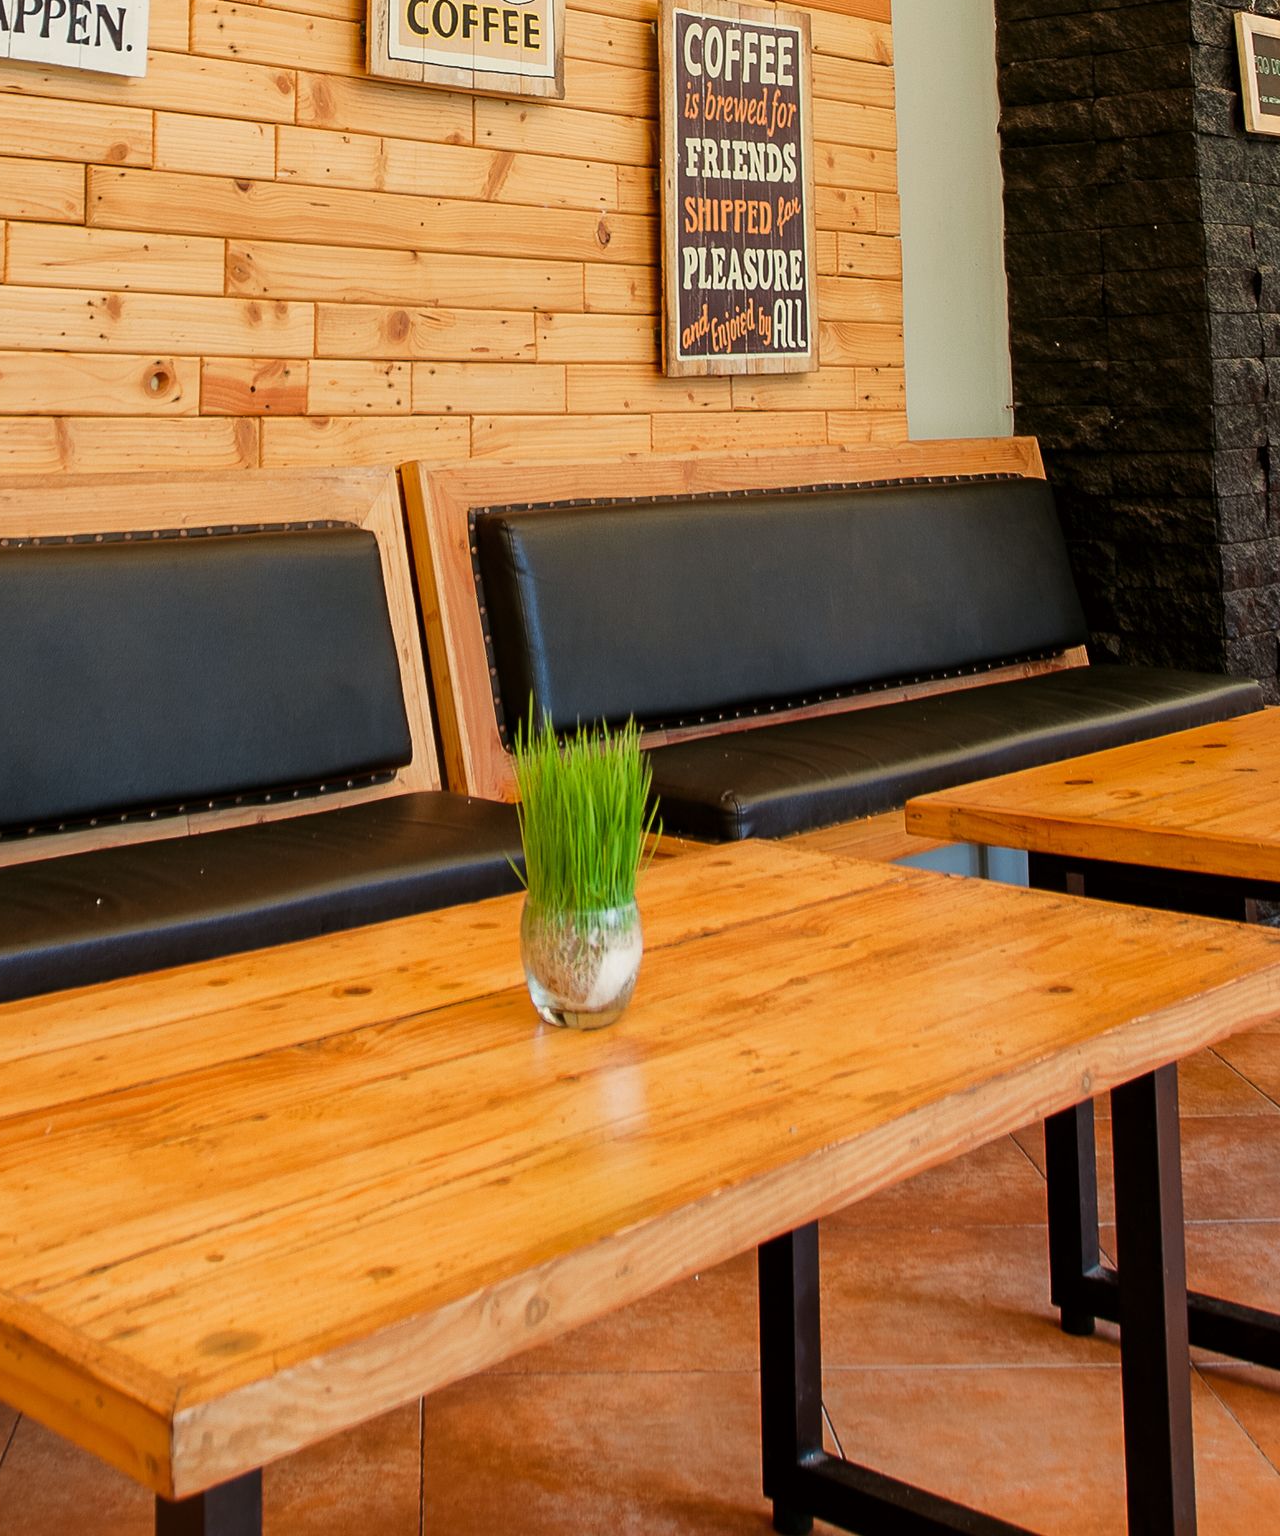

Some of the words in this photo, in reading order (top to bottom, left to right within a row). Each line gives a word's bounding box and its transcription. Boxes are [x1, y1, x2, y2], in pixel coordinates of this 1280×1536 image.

[683, 22, 795, 87] COFFEE
[684, 82, 700, 120] is
[703, 81, 769, 127] brewed
[767, 88, 797, 137] for
[684, 137, 797, 183] FRIENDS
[684, 196, 772, 235] SHIPPED
[682, 246, 804, 292] PLEASURE
[682, 304, 710, 351] and
[758, 306, 773, 347] by
